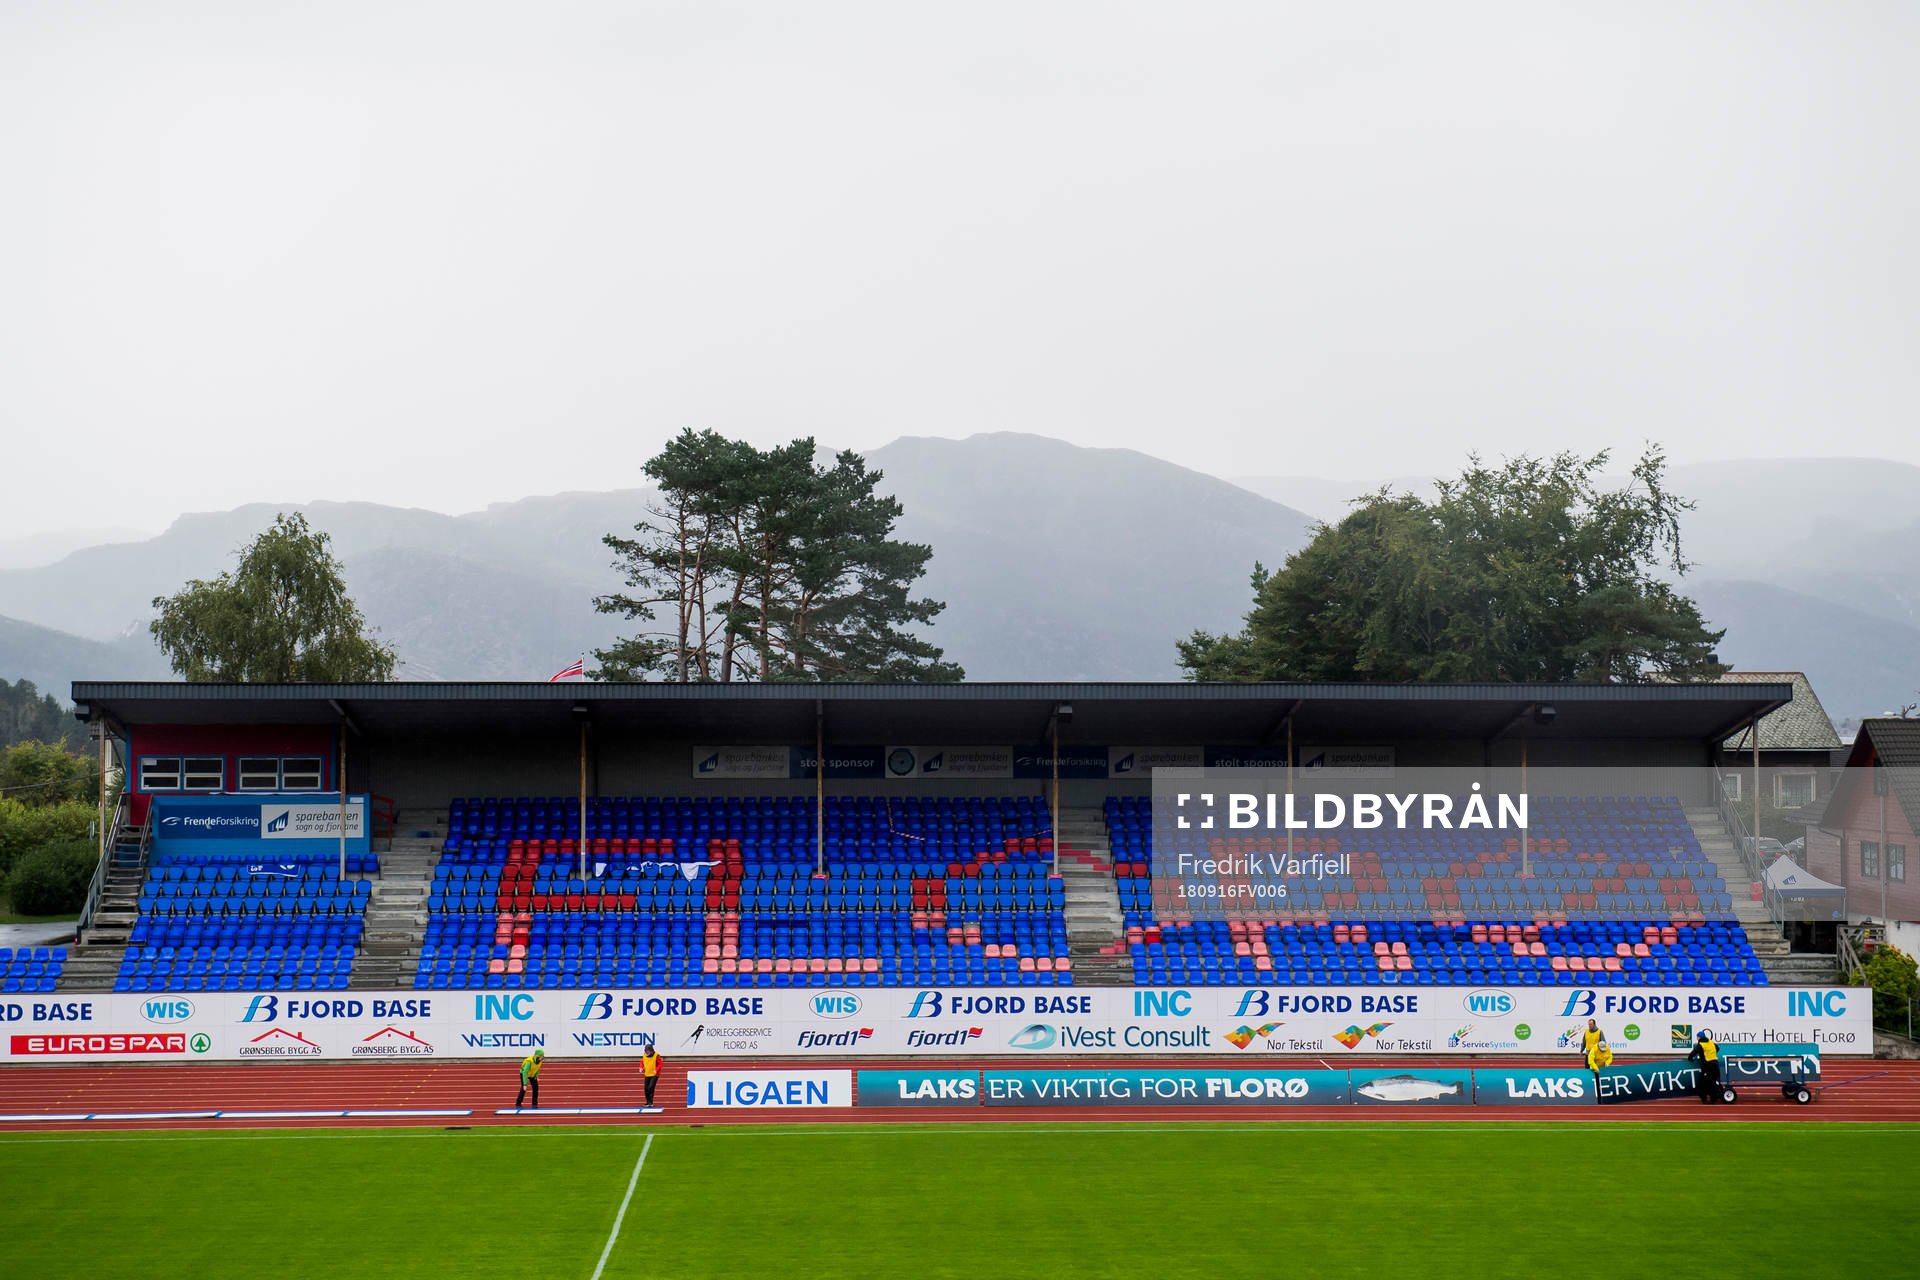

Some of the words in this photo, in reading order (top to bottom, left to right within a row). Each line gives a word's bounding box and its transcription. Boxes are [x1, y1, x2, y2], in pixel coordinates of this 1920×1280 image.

[800, 758, 825, 767] stot
[829, 759, 874, 769] sponsor
[184, 816, 258, 828] FrendeForsikring
[295, 811, 358, 823] sparebanen
[295, 824, 312, 833] sogn
[314, 824, 323, 833] og
[324, 822, 358, 833] fjorane
[146, 1001, 190, 1018] WIS
[288, 1001, 363, 1018] FJORD
[373, 1000, 430, 1017] BASE
[475, 994, 534, 1020] INC
[623, 998, 696, 1016] FJORD
[706, 998, 762, 1015] BASE
[815, 996, 857, 1013] WIS
[952, 997, 1025, 1014] FJORD
[1035, 996, 1090, 1013] BASE
[1135, 991, 1191, 1016] INC
[1279, 996, 1351, 1013] FJORD
[1362, 996, 1417, 1013] BASE
[1469, 996, 1511, 1012] WIS
[1606, 996, 1679, 1013] FJORD
[1689, 996, 1744, 1013] BASE
[1789, 991, 1846, 1017] INC
[33, 1003, 92, 1021] BASE
[462, 1034, 544, 1047] WESTCON
[573, 1033, 655, 1047] WESTCON
[706, 1028, 772, 1037] RØRLEGGERSERVICE
[1062, 1027, 1116, 1047] iVest
[1125, 1025, 1210, 1047] Consult
[28, 1037, 183, 1052] EUROSPAR
[240, 1047, 285, 1055] GRØNSBERG
[288, 1047, 309, 1055] BYGG
[312, 1046, 322, 1055] AS
[352, 1046, 398, 1054] GRØNSBERG
[400, 1046, 421, 1054] BYGG
[724, 1041, 747, 1049] FLORØ
[749, 1041, 758, 1049] AS
[1267, 1040, 1286, 1051] Nor
[1289, 1039, 1323, 1051] Tekstil
[1376, 1040, 1395, 1051] Nor
[1398, 1039, 1432, 1051] Tekstil
[1462, 1040, 1518, 1049] ServiceSystem
[899, 1079, 975, 1098] LAKS
[989, 1080, 1024, 1098] ER
[1032, 1079, 1130, 1097] VIKTIG
[1141, 1079, 1197, 1097] FOR
[1206, 1079, 1308, 1097] FLORØ
[1506, 1078, 1583, 1097] LAKS
[1637, 1068, 1702, 1093] VIKT
[708, 1081, 827, 1105] LIGAEN
